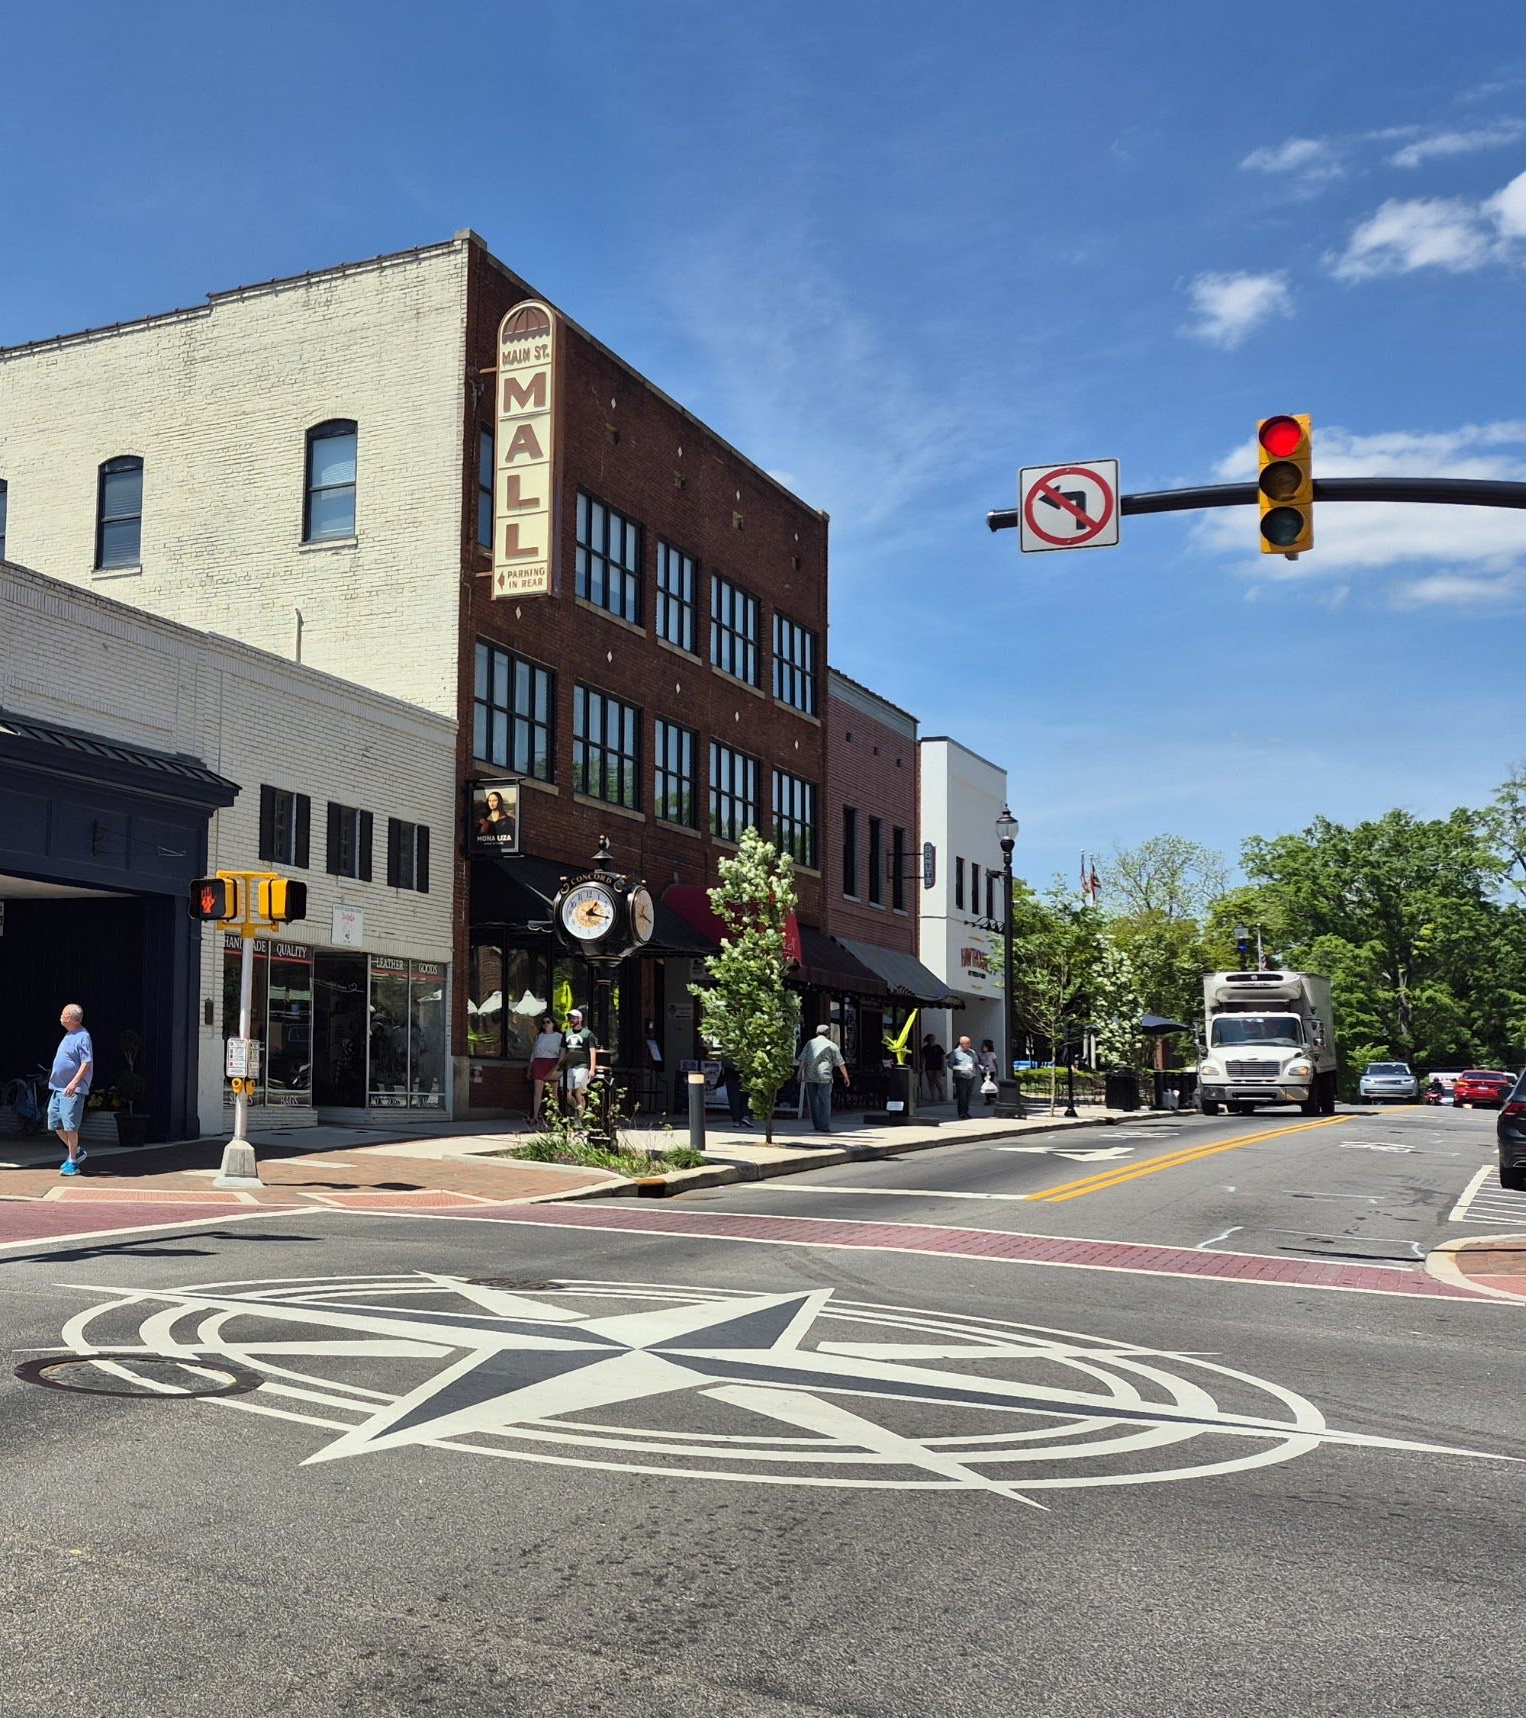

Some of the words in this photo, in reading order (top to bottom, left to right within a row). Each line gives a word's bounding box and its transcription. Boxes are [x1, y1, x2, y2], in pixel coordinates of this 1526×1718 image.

[502, 347, 531, 367] MAIN
[534, 343, 550, 361] ST.
[503, 371, 547, 560] MALL
[507, 566, 545, 579] PARKING
[508, 580, 518, 589] IN
[521, 577, 543, 588] REAR
[496, 834, 512, 842] LIZA
[570, 873, 613, 885] CONCORD
[225, 935, 267, 953] HANADE
[276, 943, 308, 959] QUALITY
[376, 957, 405, 971] LEATHER
[418, 962, 439, 975] GOODS
